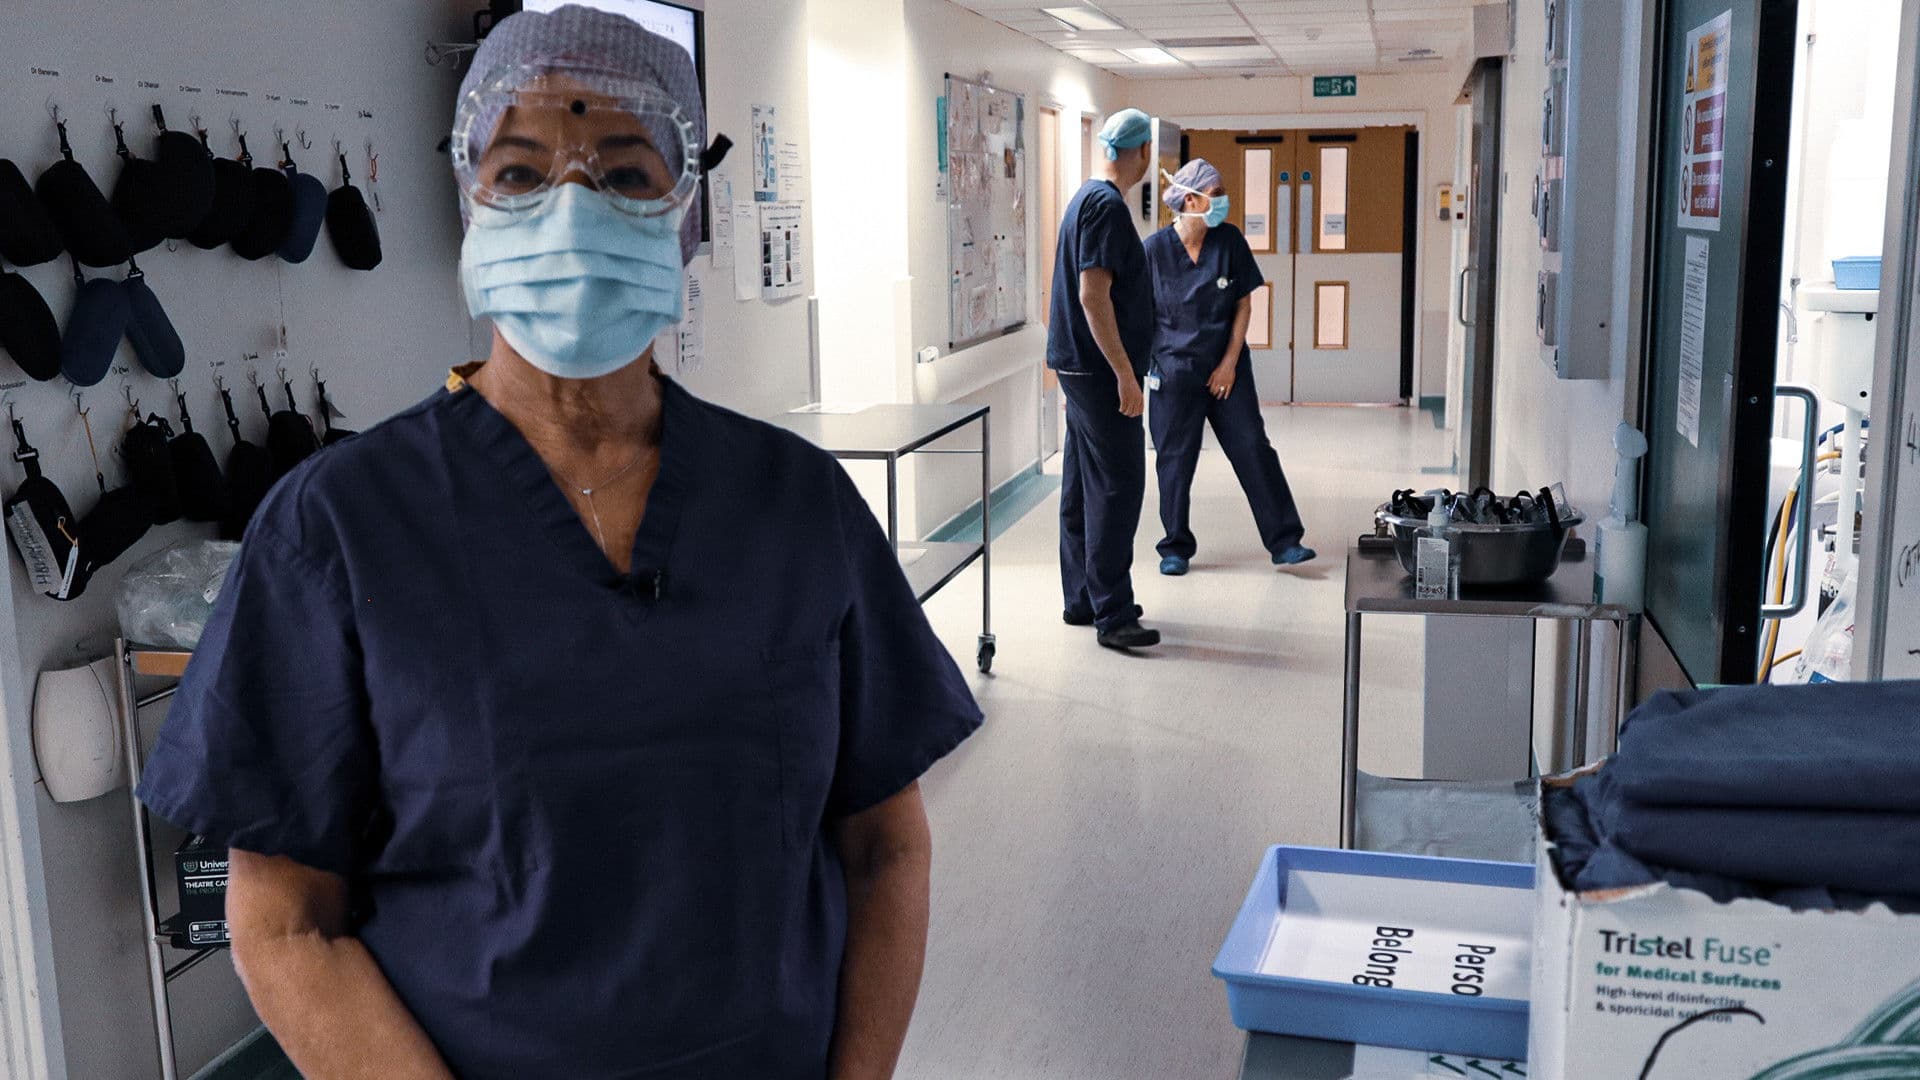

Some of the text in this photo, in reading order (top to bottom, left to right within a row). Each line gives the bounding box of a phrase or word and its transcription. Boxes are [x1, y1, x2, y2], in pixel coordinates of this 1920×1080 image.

[185, 880, 214, 889] THEATRE
[1352, 926, 1414, 989] Belong
[1598, 929, 1695, 960] Tristel
[1451, 944, 1497, 997] Perso
[1596, 962, 1781, 991] for Medical Surfaces
[1595, 1001, 1605, 1012] &
[1610, 1004, 1675, 1019] sporicidal
[1597, 985, 1746, 1009] High-level disinfecting
